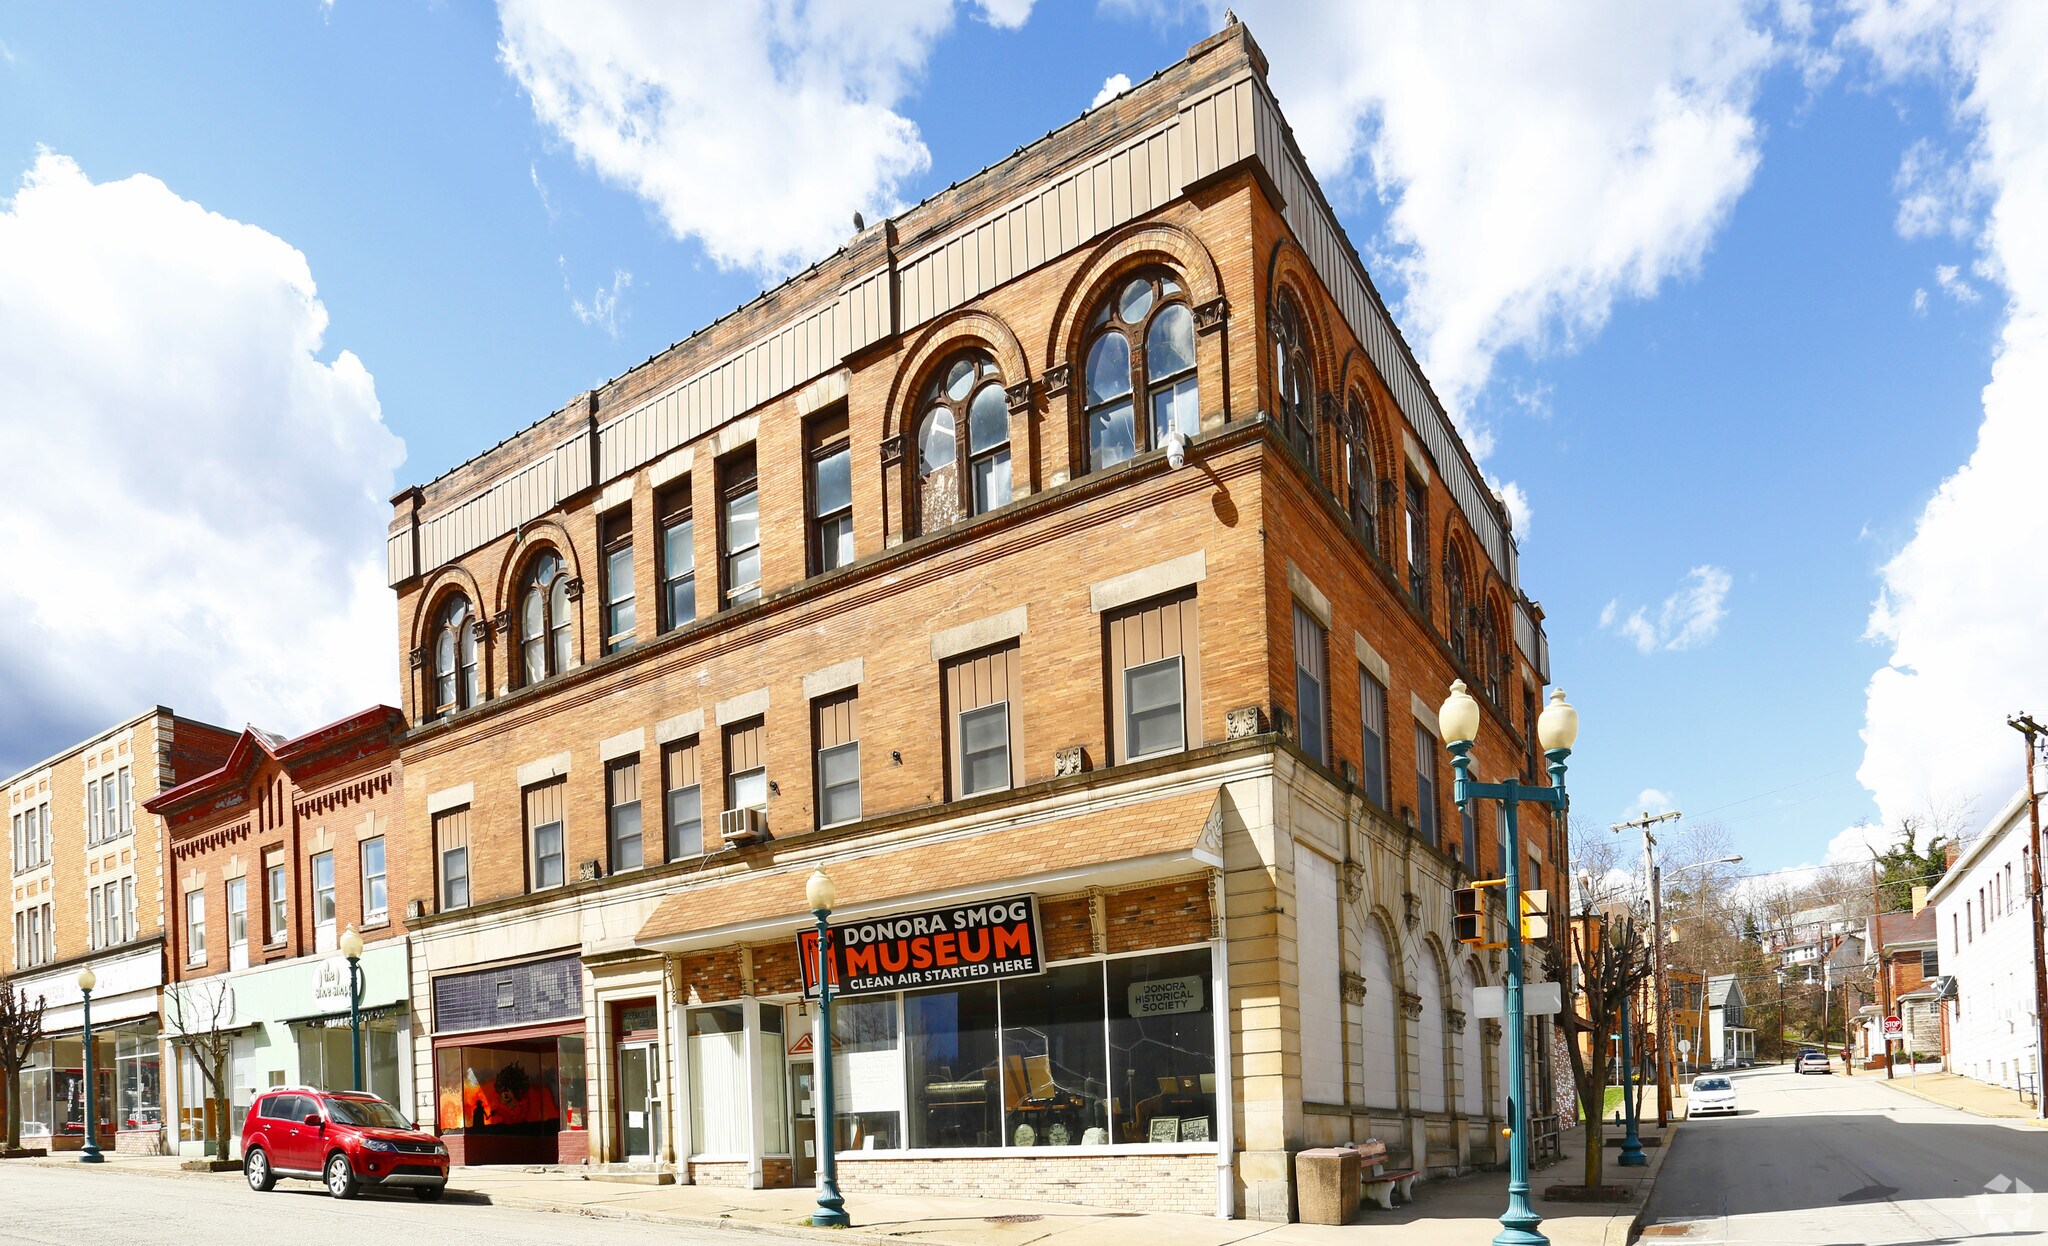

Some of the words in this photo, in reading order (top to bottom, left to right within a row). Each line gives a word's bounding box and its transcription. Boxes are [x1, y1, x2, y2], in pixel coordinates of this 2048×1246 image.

[844, 914, 947, 946] DONORA
[953, 902, 1027, 929] SMOG
[845, 922, 1032, 977] MUSEUM
[850, 975, 894, 990] CLEAN
[897, 972, 922, 985] AIR
[925, 964, 989, 982] STARTED
[993, 958, 1033, 974] HERE
[1143, 982, 1187, 994] DONORA
[1135, 990, 1194, 1004] HISTORICAL
[1142, 1000, 1188, 1012] SOCIETY
[1885, 1020, 1900, 1028] STOP
